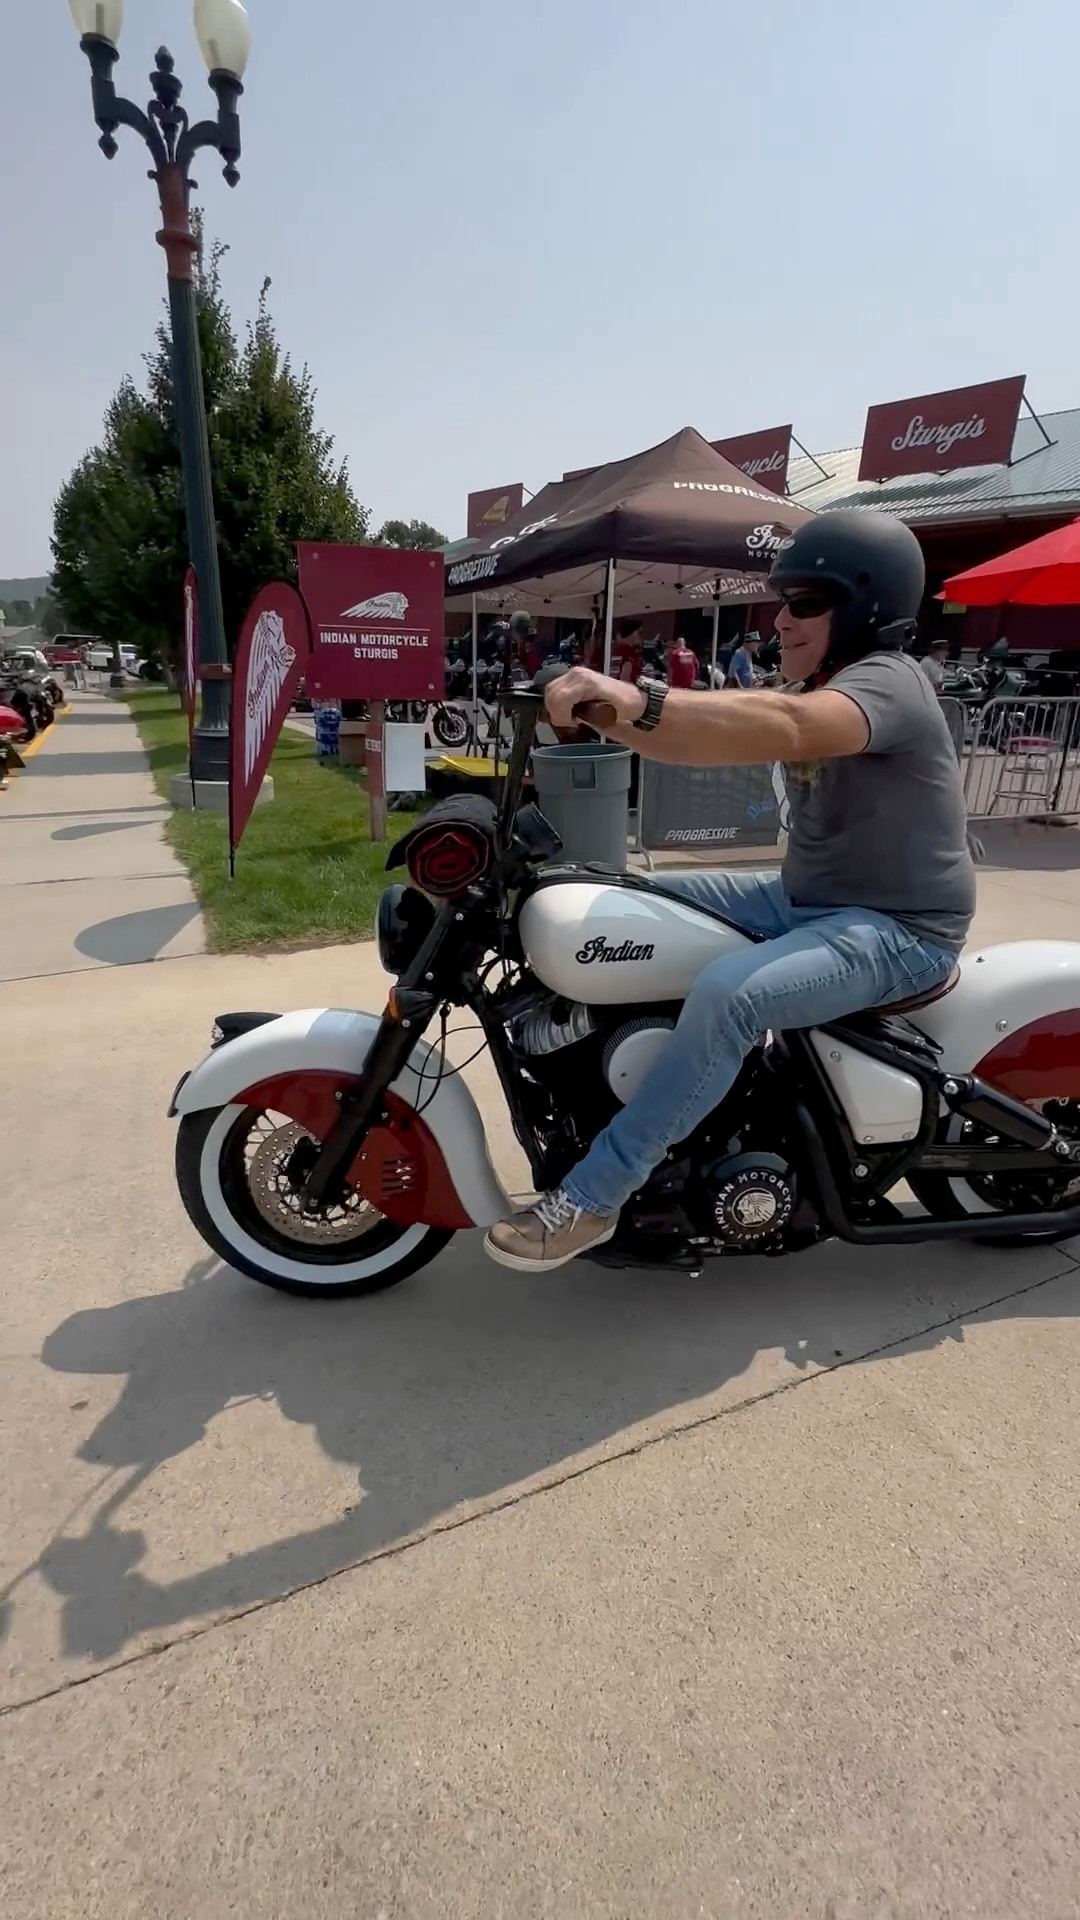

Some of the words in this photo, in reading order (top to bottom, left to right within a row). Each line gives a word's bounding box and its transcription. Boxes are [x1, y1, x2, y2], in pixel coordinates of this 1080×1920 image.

[891, 414, 987, 454] Sturgis
[739, 450, 786, 477] cycle
[748, 550, 777, 559] MOTO
[320, 632, 357, 644] INDIAN
[360, 634, 429, 646] MOTORCYCLE
[354, 648, 398, 659] STURGIS
[665, 827, 742, 841] PROGRESSIVE
[575, 936, 655, 964] Indian
[714, 1182, 735, 1231] INDIAN
[738, 1171, 792, 1227] MOTORCYCLE
